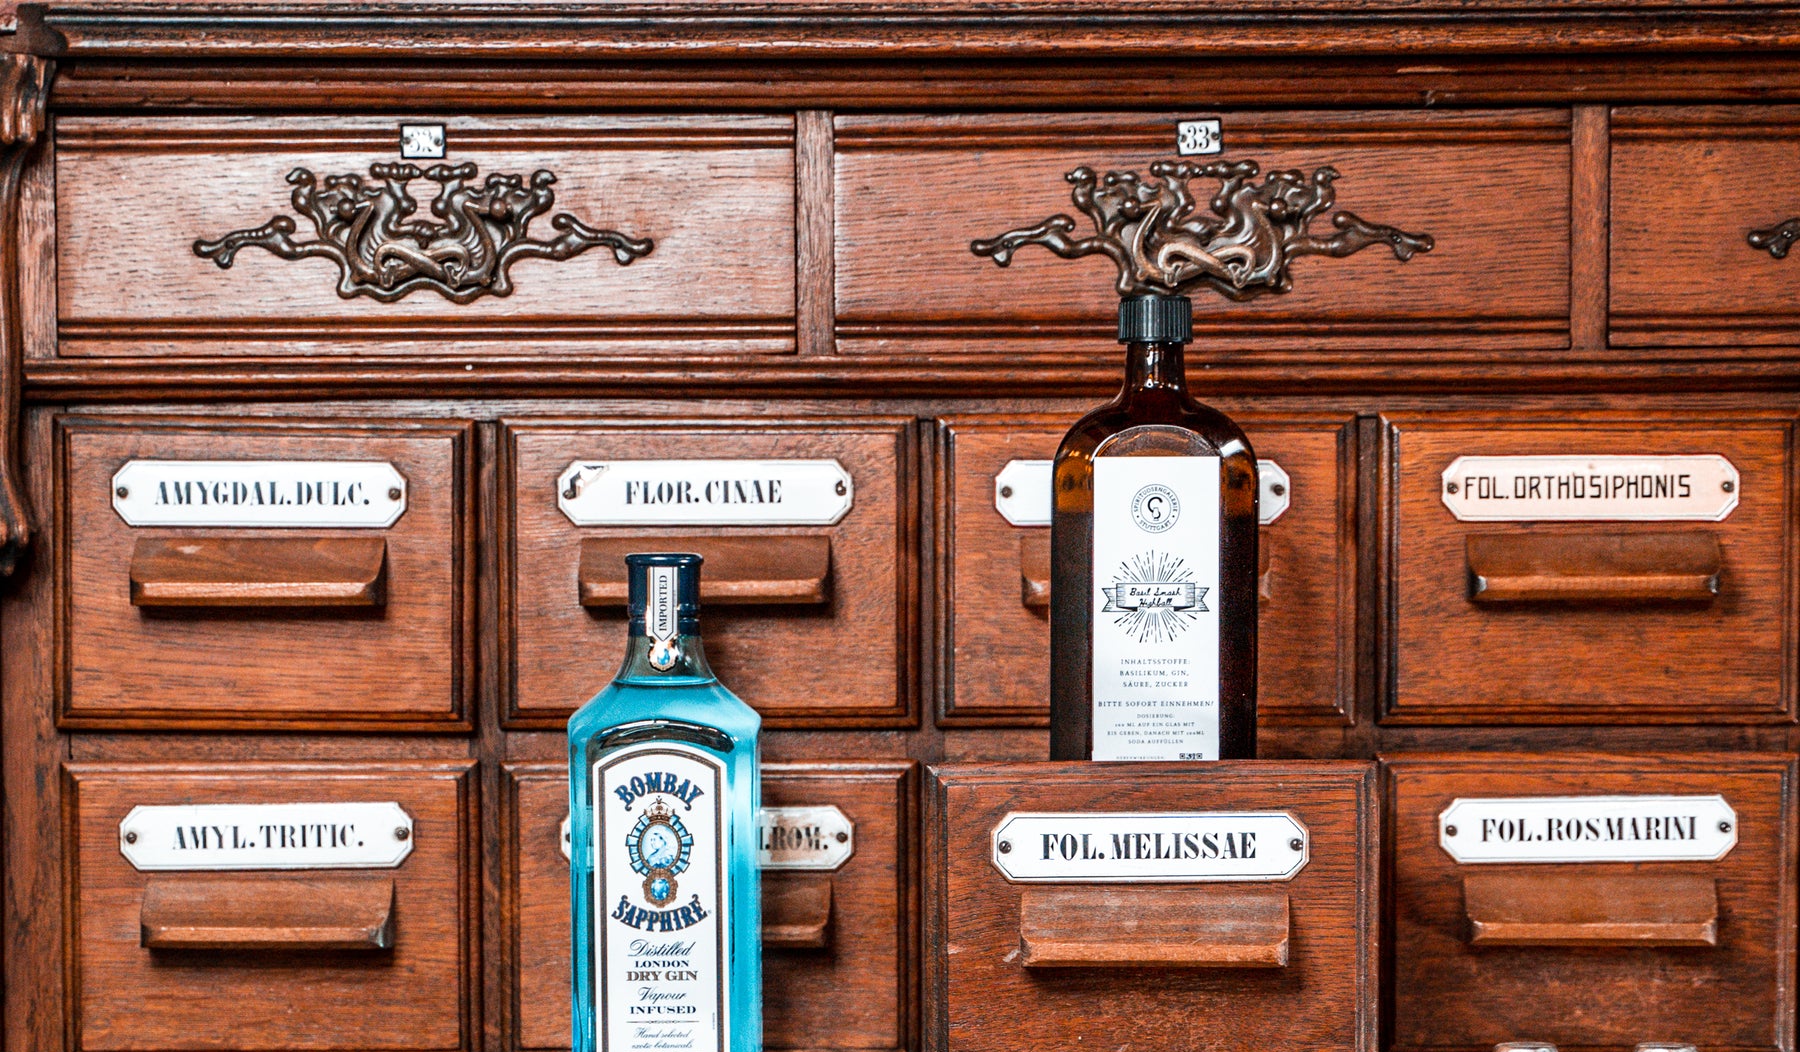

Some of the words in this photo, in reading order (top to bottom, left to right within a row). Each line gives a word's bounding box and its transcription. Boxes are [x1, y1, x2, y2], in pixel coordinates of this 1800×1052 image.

[1187, 125, 1210, 150] 33
[1133, 486, 1178, 513] SPIRITUOSENGALERIE
[1138, 519, 1172, 532] STUTTGART
[659, 574, 668, 632] IMPORTED
[613, 771, 705, 812] BOMBAY
[611, 893, 708, 933] SAPPHIRE
[628, 938, 696, 957] Distilled
[635, 960, 690, 968] LONDON
[626, 970, 662, 982] DRY
[664, 970, 698, 981] GIN
[638, 986, 687, 1004] Vapour
[630, 1006, 697, 1015] INFUSED
